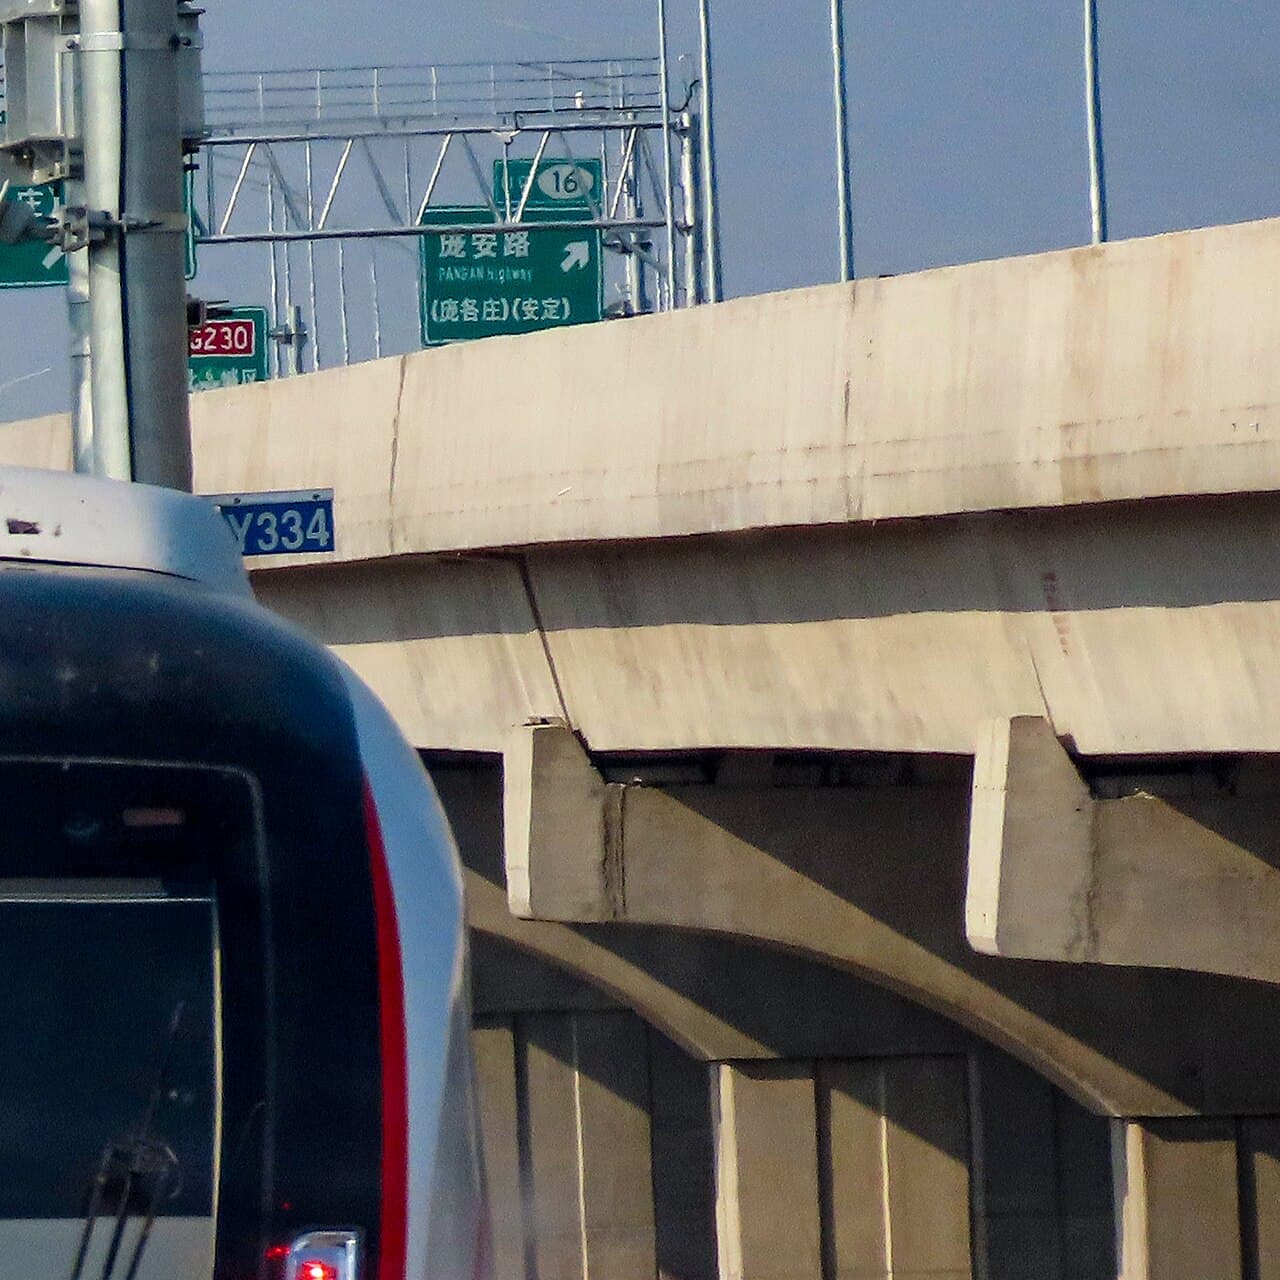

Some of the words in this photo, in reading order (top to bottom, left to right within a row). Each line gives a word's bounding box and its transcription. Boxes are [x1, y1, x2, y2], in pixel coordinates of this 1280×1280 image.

[553, 169, 578, 194] 16
[190, 325, 248, 351] G230
[227, 508, 330, 552] Y334
